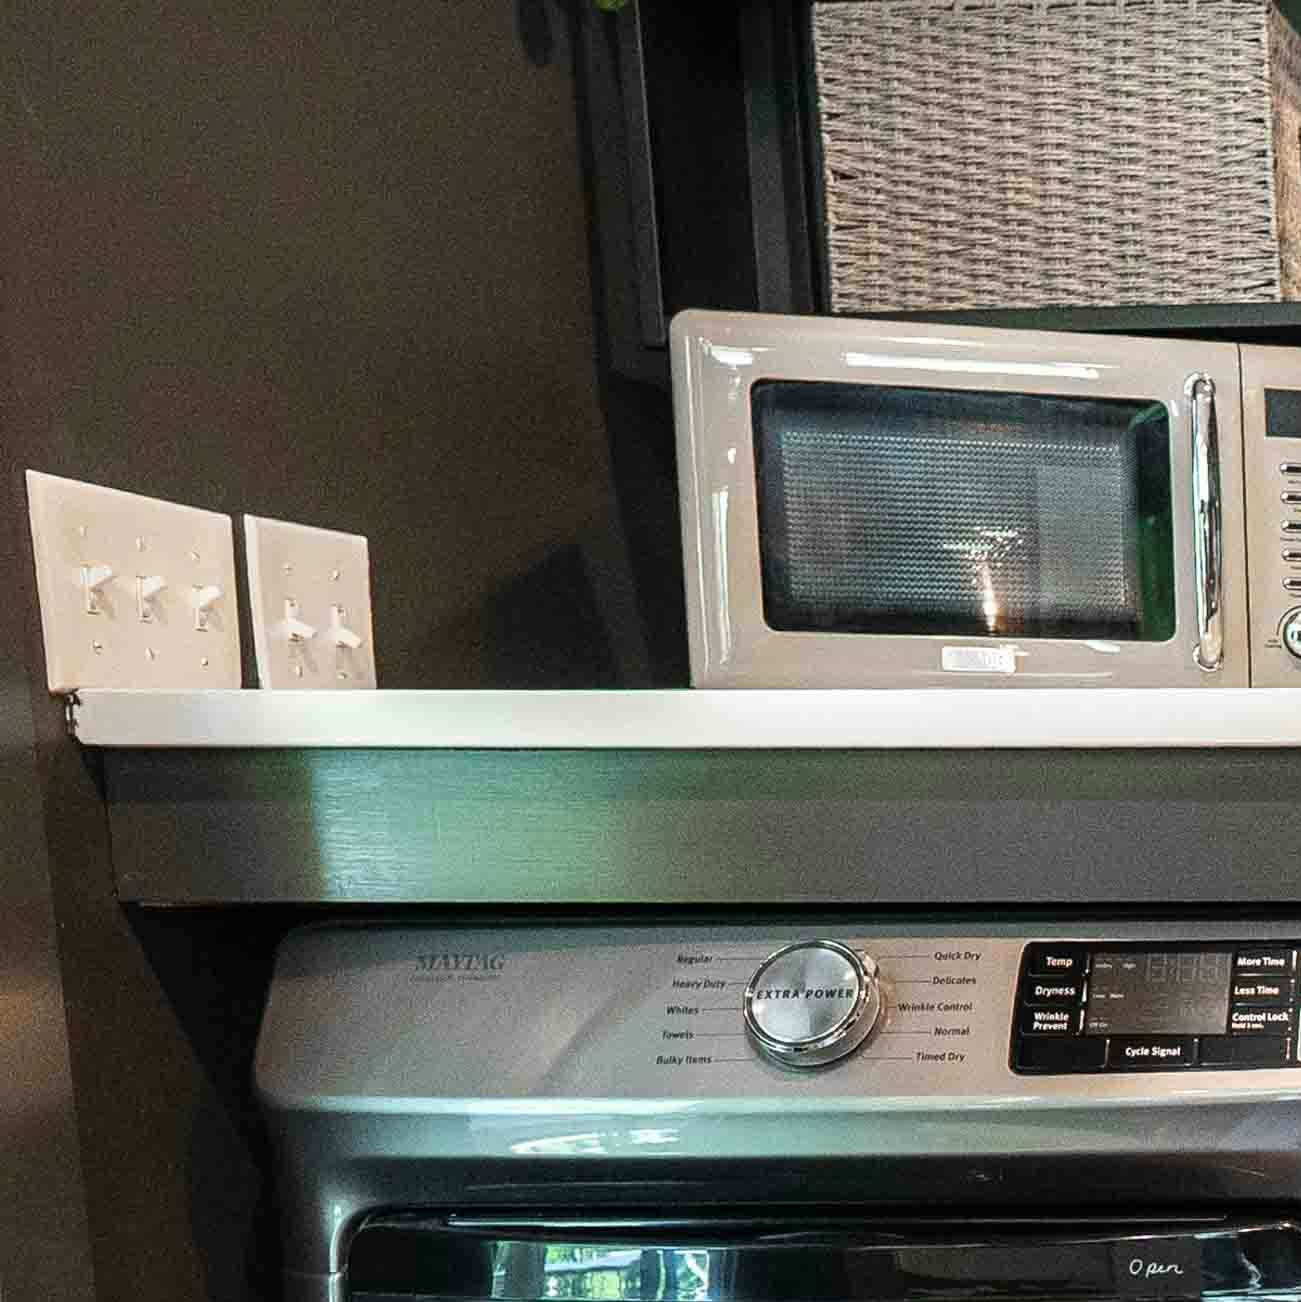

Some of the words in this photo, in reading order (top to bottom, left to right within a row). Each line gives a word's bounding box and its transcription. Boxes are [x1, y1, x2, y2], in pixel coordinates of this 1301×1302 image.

[676, 953, 713, 966] Regular
[933, 951, 961, 961] Quick
[963, 951, 982, 962] Dry
[1045, 956, 1073, 968] Temp
[1237, 956, 1261, 967] More
[1262, 956, 1285, 966] Time
[672, 979, 702, 991] Heavy
[703, 979, 727, 991] Duty
[932, 975, 977, 986] Delicates
[756, 989, 800, 1000] EXTRA
[804, 988, 854, 999] POWER
[1034, 985, 1076, 997] Dryness
[1234, 985, 1255, 996] Less
[1256, 985, 1279, 995] Time
[666, 1005, 699, 1016] Whites
[897, 1002, 935, 1013] Wrinkle
[936, 1002, 974, 1012] Control
[1033, 1011, 1069, 1022] Wrinkle
[1232, 1011, 1266, 1022] Control
[1267, 1011, 1289, 1022] Lock
[933, 1026, 970, 1037] Normal
[1032, 1021, 1068, 1031] Prevent
[662, 1030, 695, 1041] Towels
[915, 1052, 946, 1063] Timed
[947, 1052, 966, 1063] Dry
[1125, 1046, 1150, 1058] Cycle
[1151, 1046, 1181, 1058] Signal
[656, 1054, 685, 1066] Bulky
[685, 1054, 713, 1065] Items
[1128, 1258, 1184, 1279] Open
